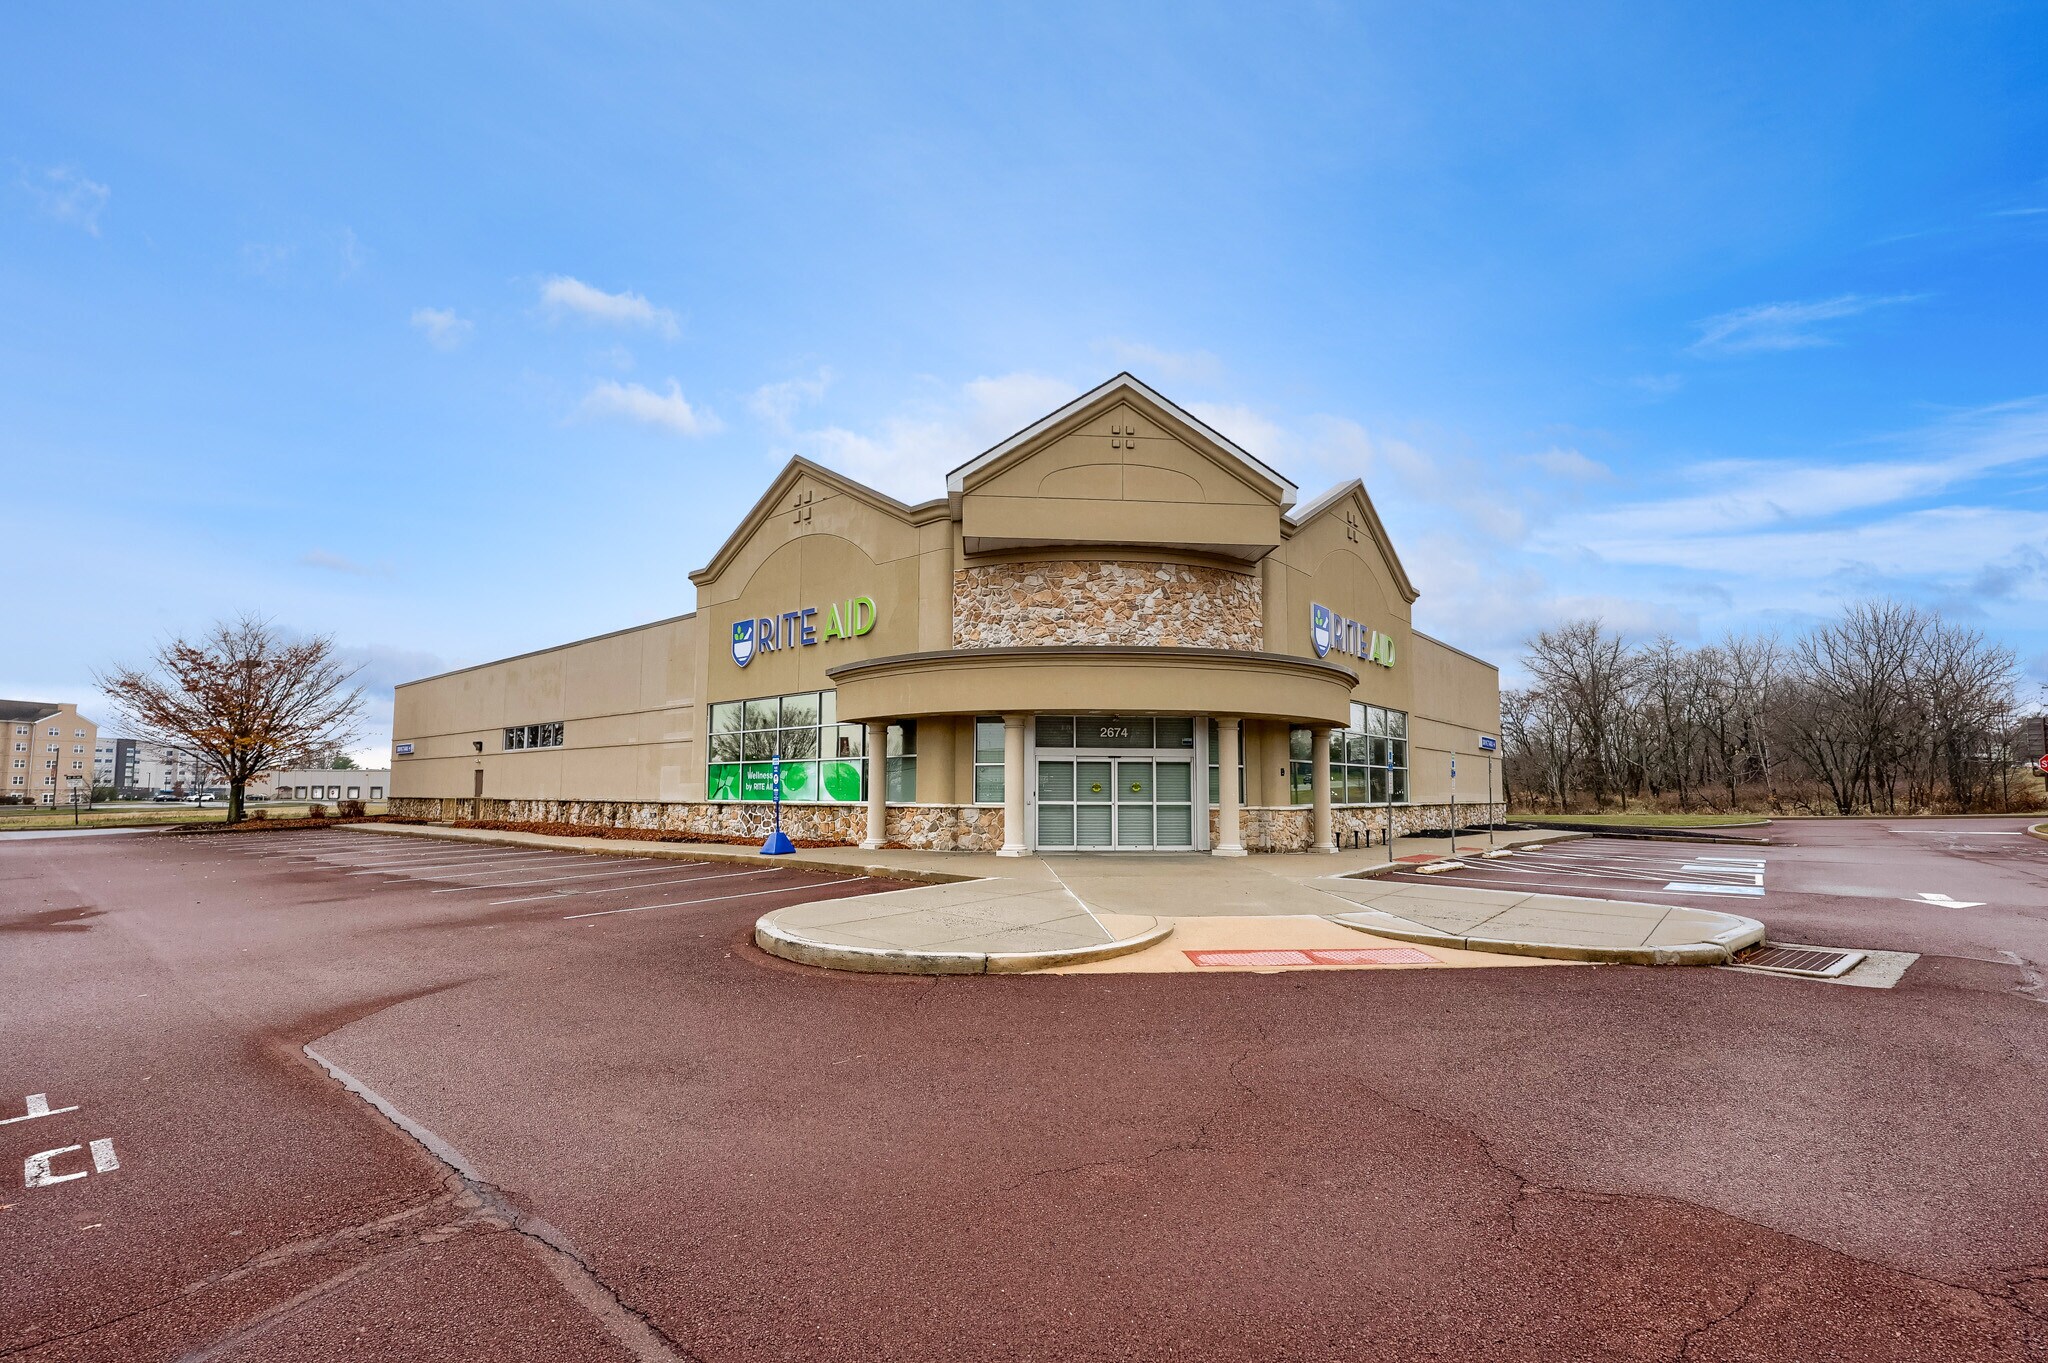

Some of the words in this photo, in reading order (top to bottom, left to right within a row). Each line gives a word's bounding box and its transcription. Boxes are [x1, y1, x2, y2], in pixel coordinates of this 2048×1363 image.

[758, 608, 817, 653] RITE
[823, 596, 877, 642] AID
[1331, 613, 1369, 660] RITE
[1369, 630, 1397, 668] AID
[1100, 727, 1128, 738] 2674
[747, 771, 773, 780] Wellness
[745, 783, 752, 791] by
